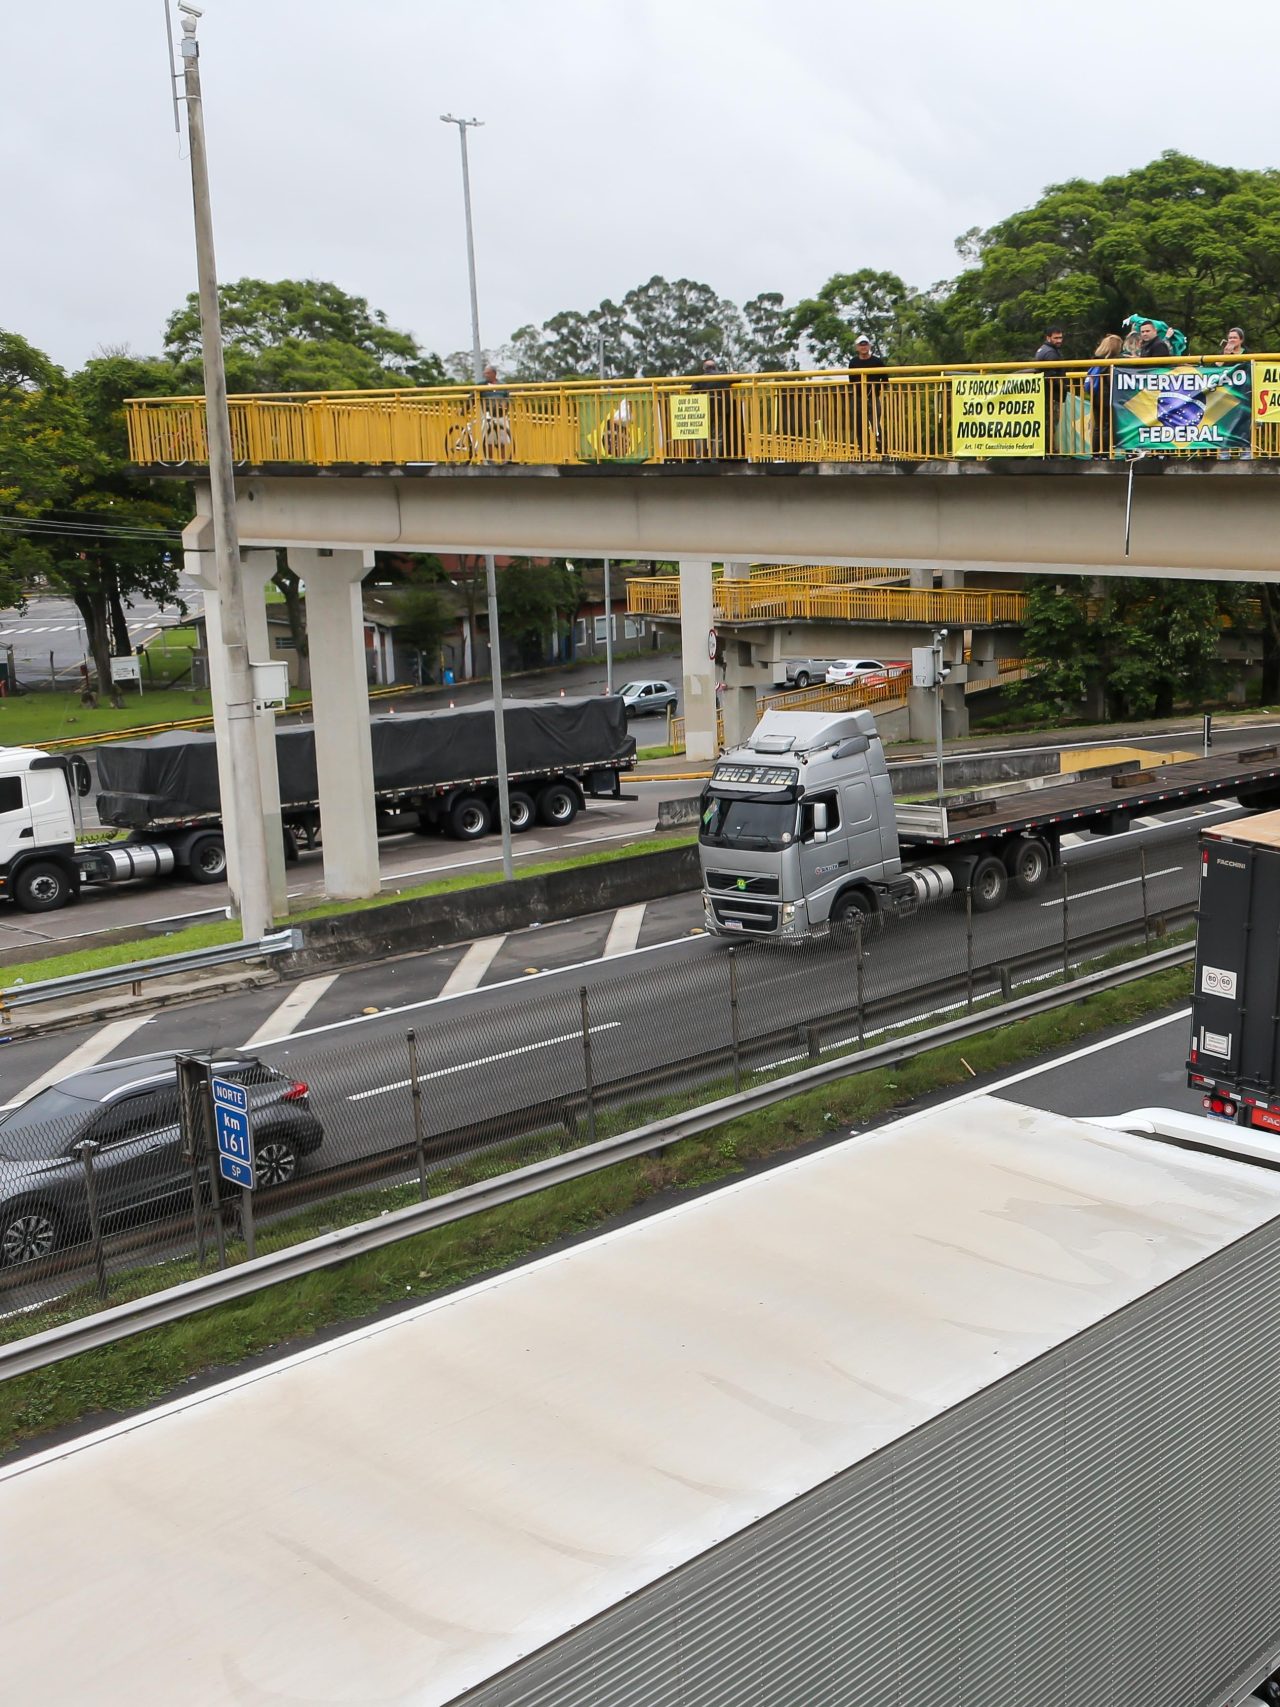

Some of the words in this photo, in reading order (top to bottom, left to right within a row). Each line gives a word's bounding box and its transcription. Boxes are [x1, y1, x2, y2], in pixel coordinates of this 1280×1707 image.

[955, 380, 966, 396] AS
[968, 379, 999, 400] FORÇAS
[1000, 378, 1041, 395] ARMADAS
[1117, 369, 1247, 391] INTERVENÇÃO
[963, 398, 983, 416] SÃO
[986, 402, 995, 415] O
[998, 400, 1035, 415] PODER
[957, 420, 1041, 438] MODERADOR
[1139, 425, 1224, 443] FEDERAL
[715, 767, 752, 782] DEUS
[763, 768, 797, 785] FIEL
[1216, 858, 1246, 869] FACCHINI
[1221, 978, 1230, 986] 60
[216, 1085, 243, 1105] NORTE
[224, 1112, 240, 1130] km
[223, 1130, 245, 1156] 161
[231, 1165, 241, 1177] SP
